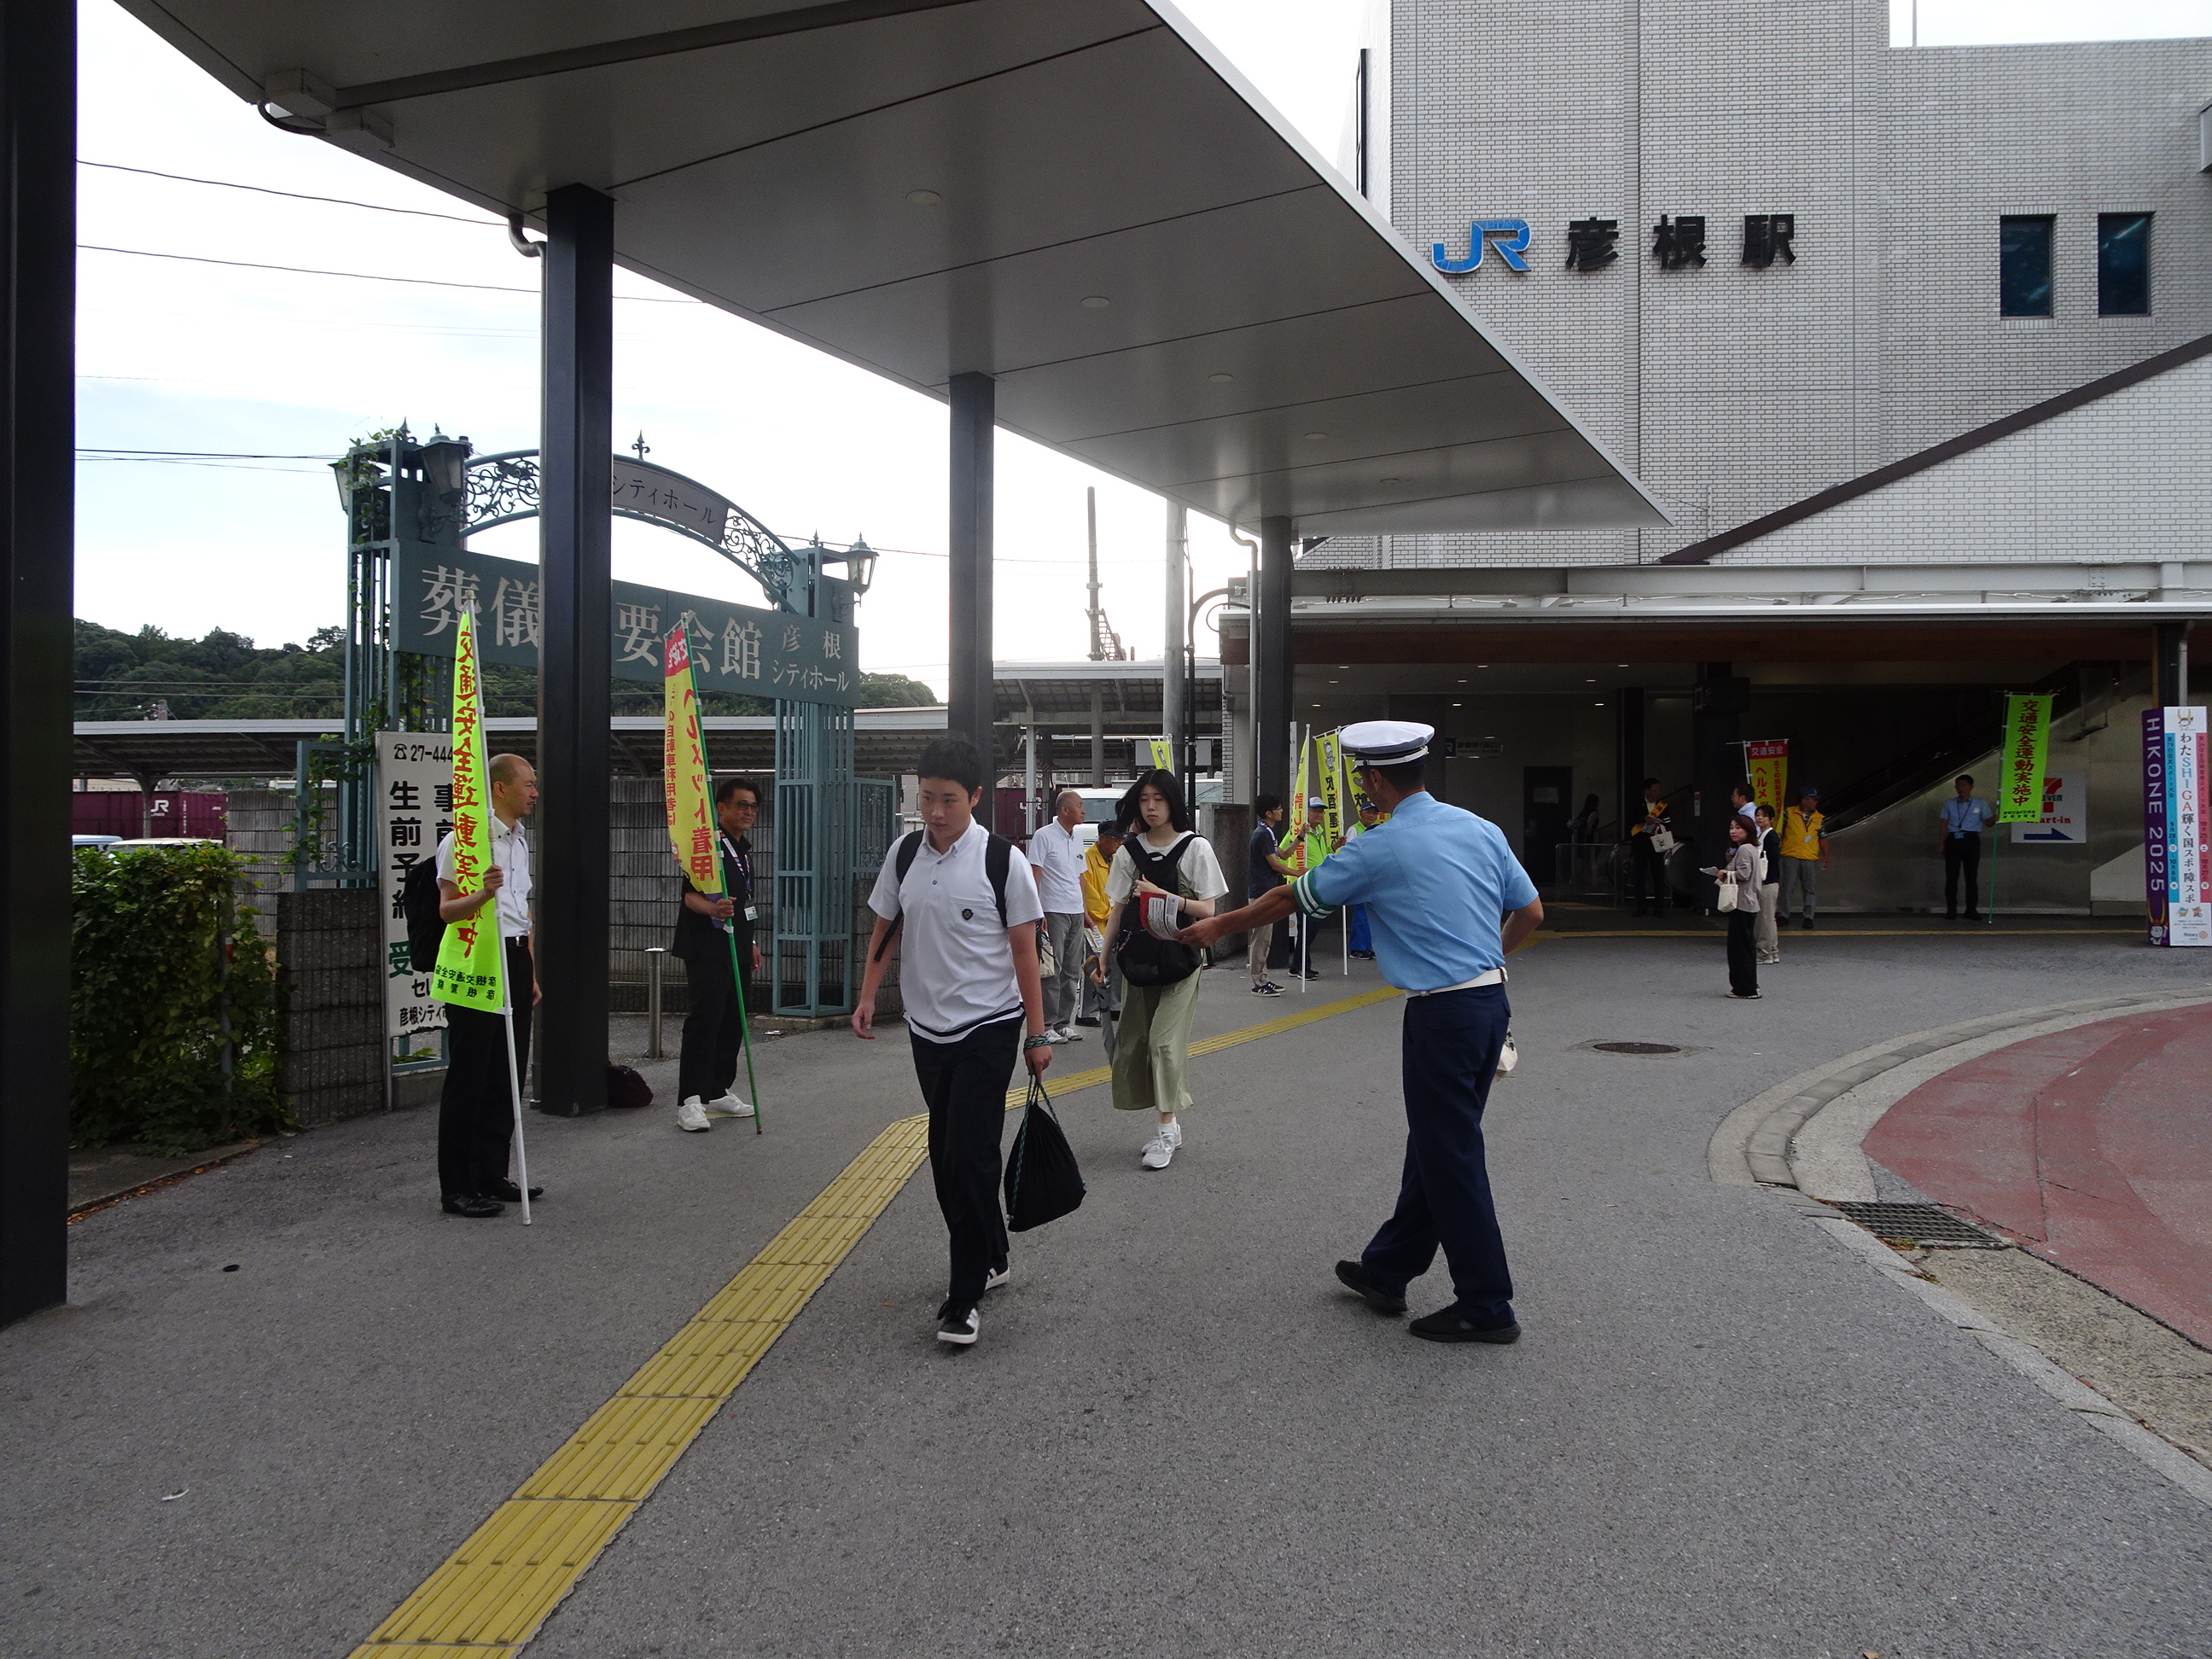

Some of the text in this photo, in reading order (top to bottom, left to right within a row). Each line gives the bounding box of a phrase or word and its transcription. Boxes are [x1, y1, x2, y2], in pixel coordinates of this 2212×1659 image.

[1431, 214, 1796, 275] JR 彦根駅
[771, 660, 850, 692] シティホール
[2012, 700, 2040, 807] 交通安全運動実施中
[150, 800, 170, 812] JR
[2146, 718, 2165, 891] HIKONE 2025
